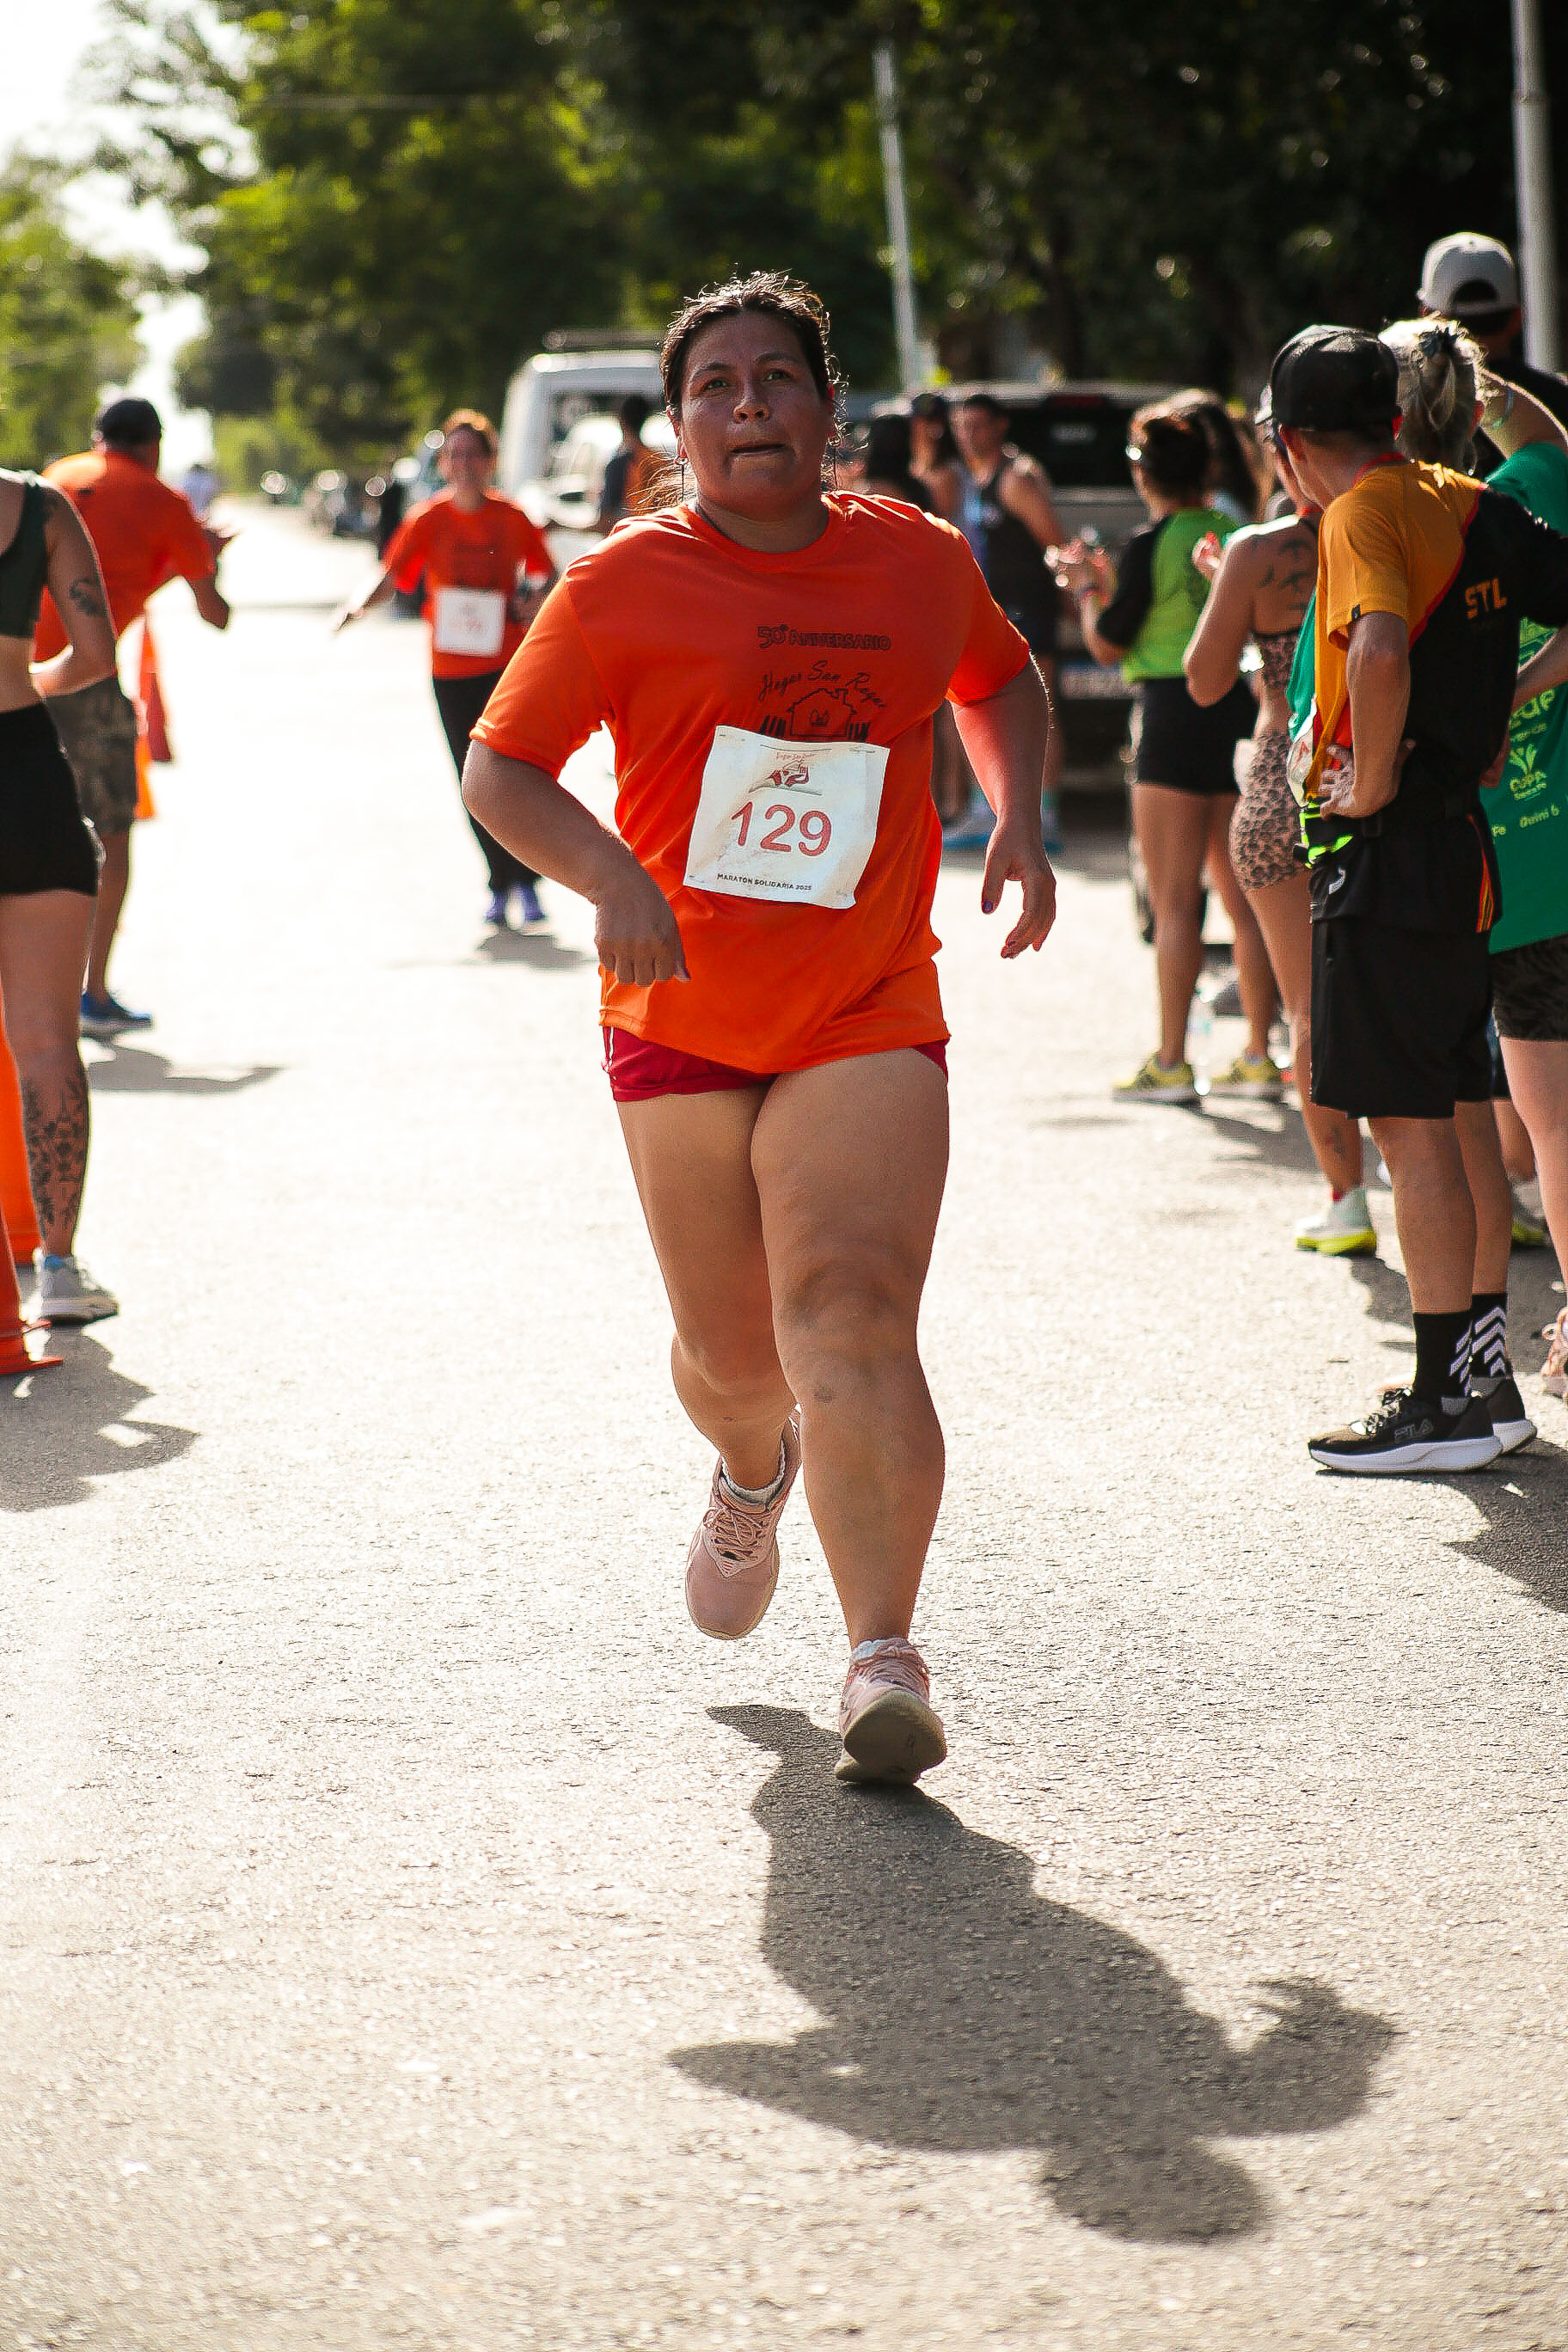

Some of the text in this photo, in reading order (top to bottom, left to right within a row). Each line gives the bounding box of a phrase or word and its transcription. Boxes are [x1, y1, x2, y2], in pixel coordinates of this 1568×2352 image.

[1465, 579, 1506, 619] STL
[732, 801, 831, 856] 129
[717, 873, 753, 885] MARATON
[754, 879, 794, 890] SOLIDARIA
